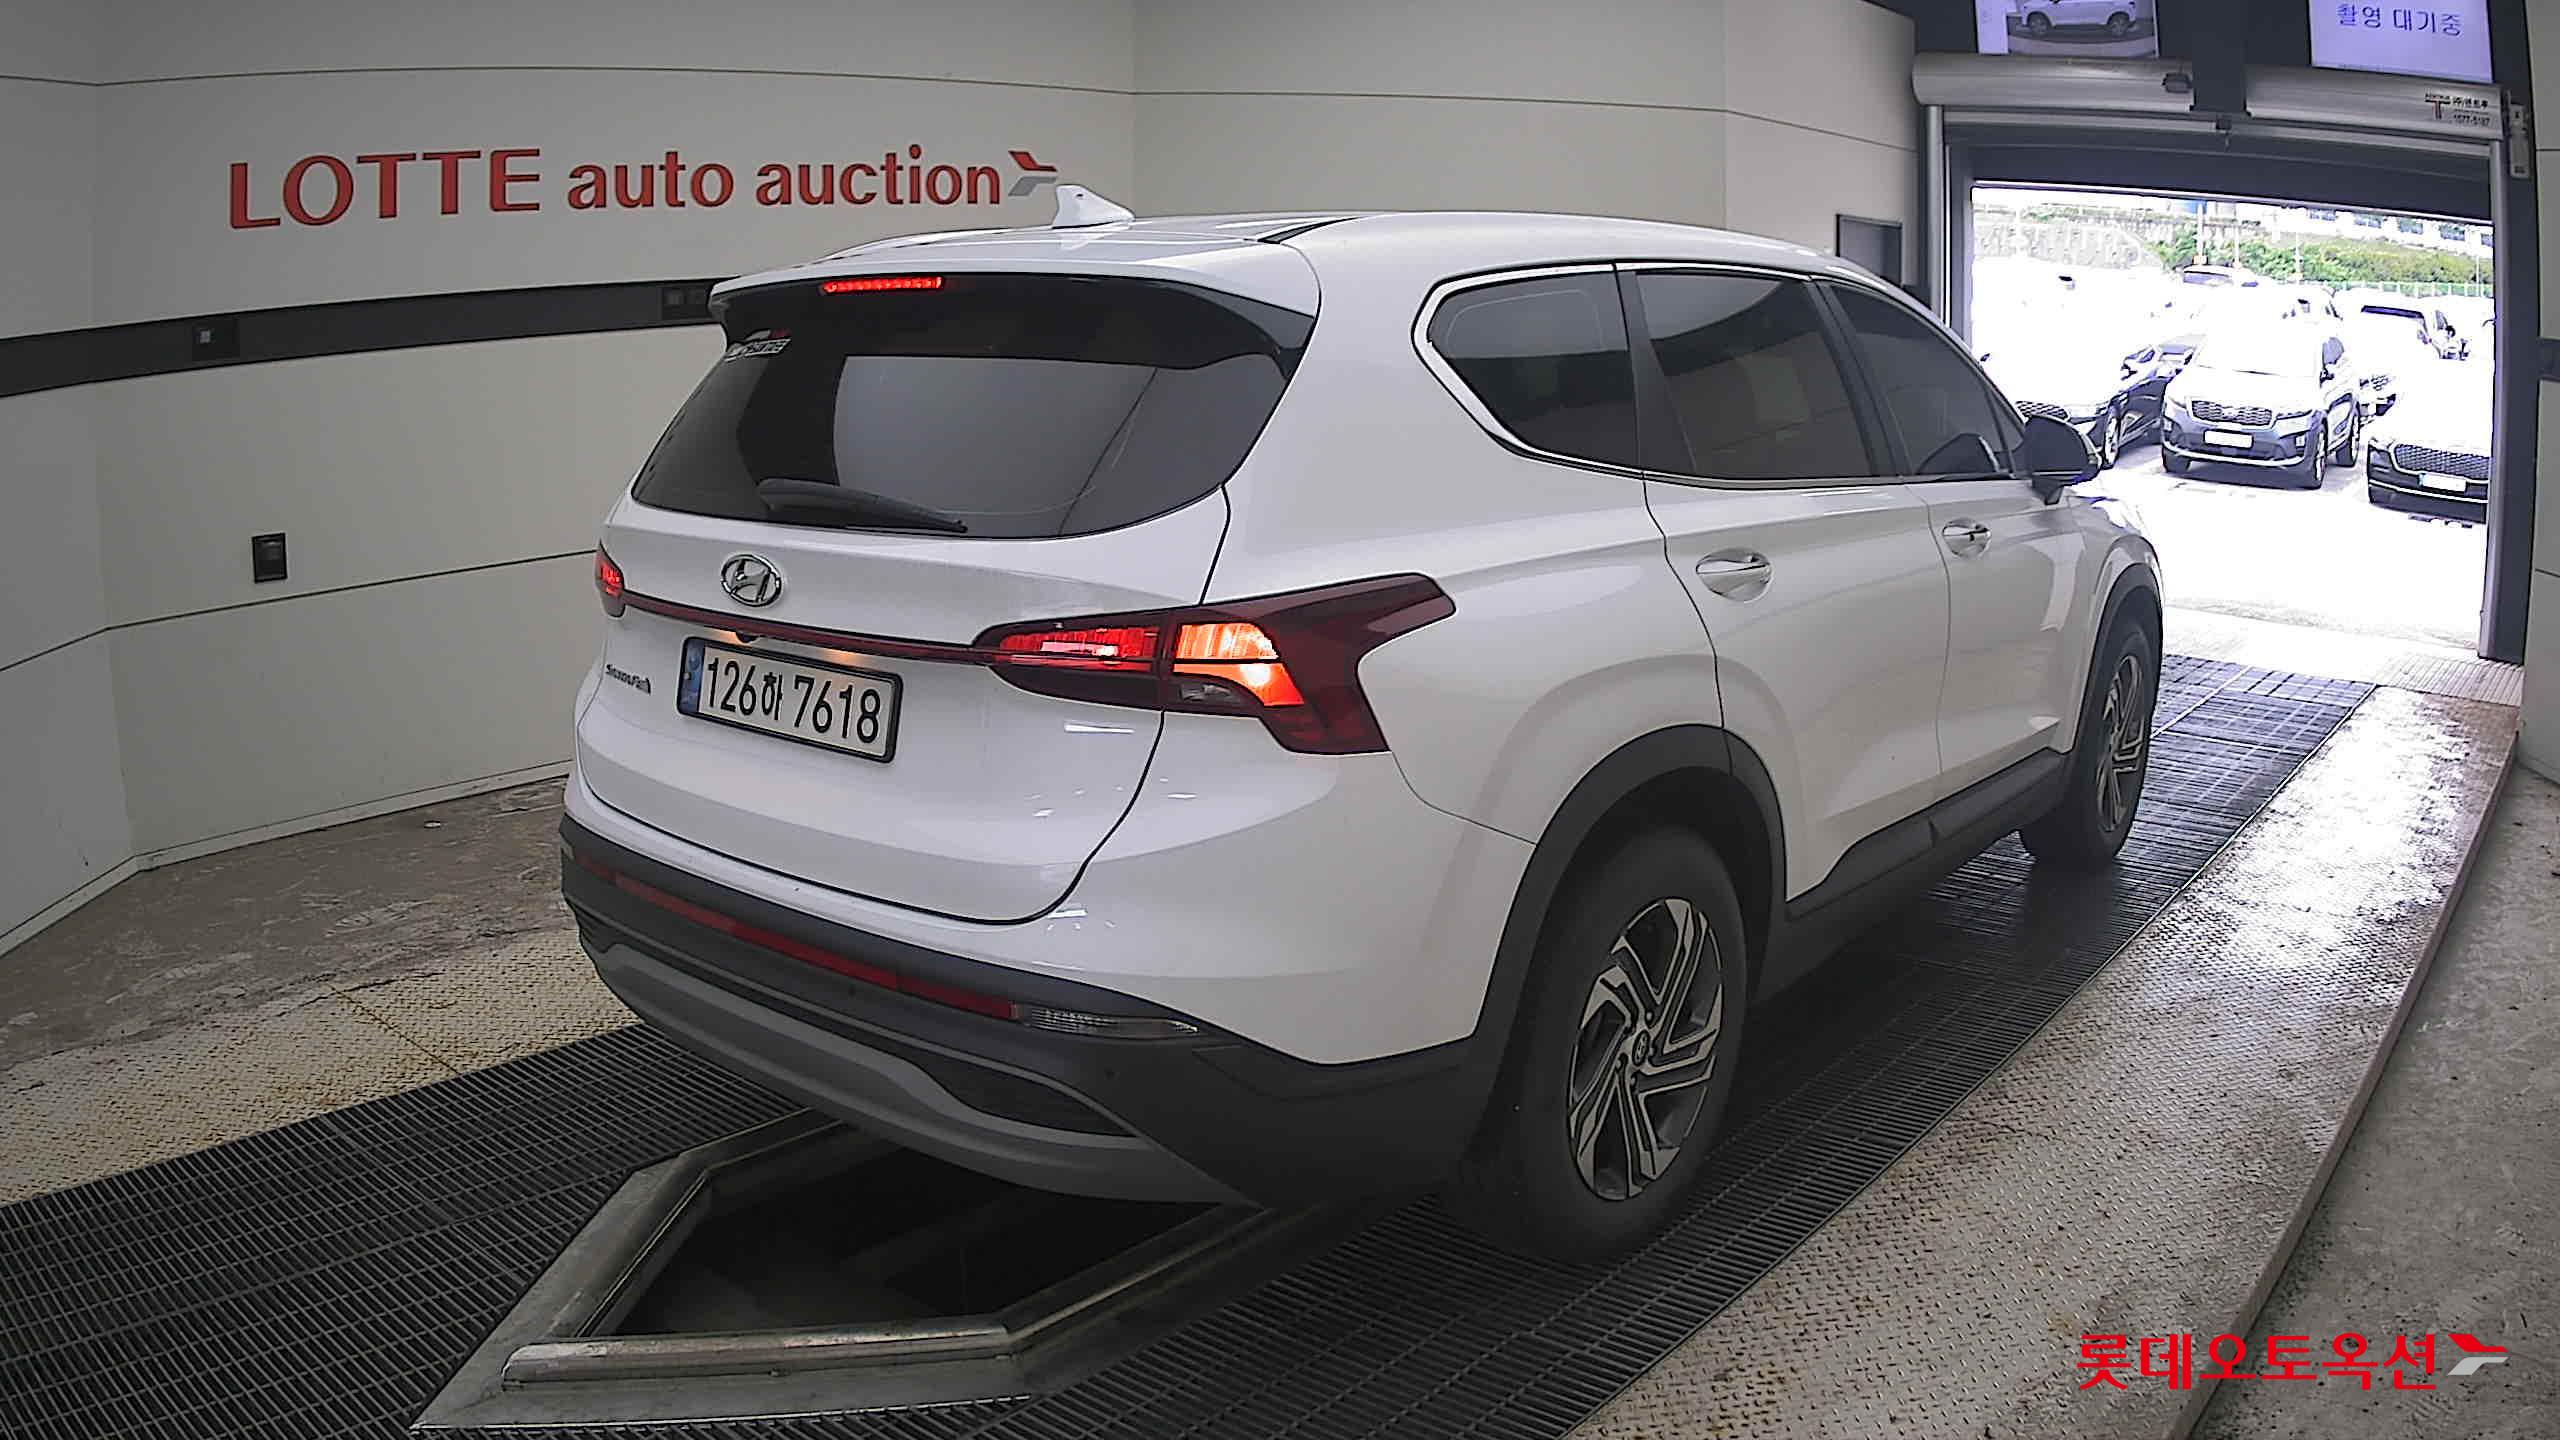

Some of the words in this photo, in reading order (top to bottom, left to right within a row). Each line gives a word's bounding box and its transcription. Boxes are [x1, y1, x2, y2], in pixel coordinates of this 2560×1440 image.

[2337, 4, 2381, 29] 촬영
[2392, 8, 2462, 37] 대기중
[230, 148, 541, 229] LOTTE
[568, 151, 736, 209] auto
[755, 145, 1002, 206] auction
[707, 657, 783, 721] 126하
[794, 674, 881, 744] 7618
